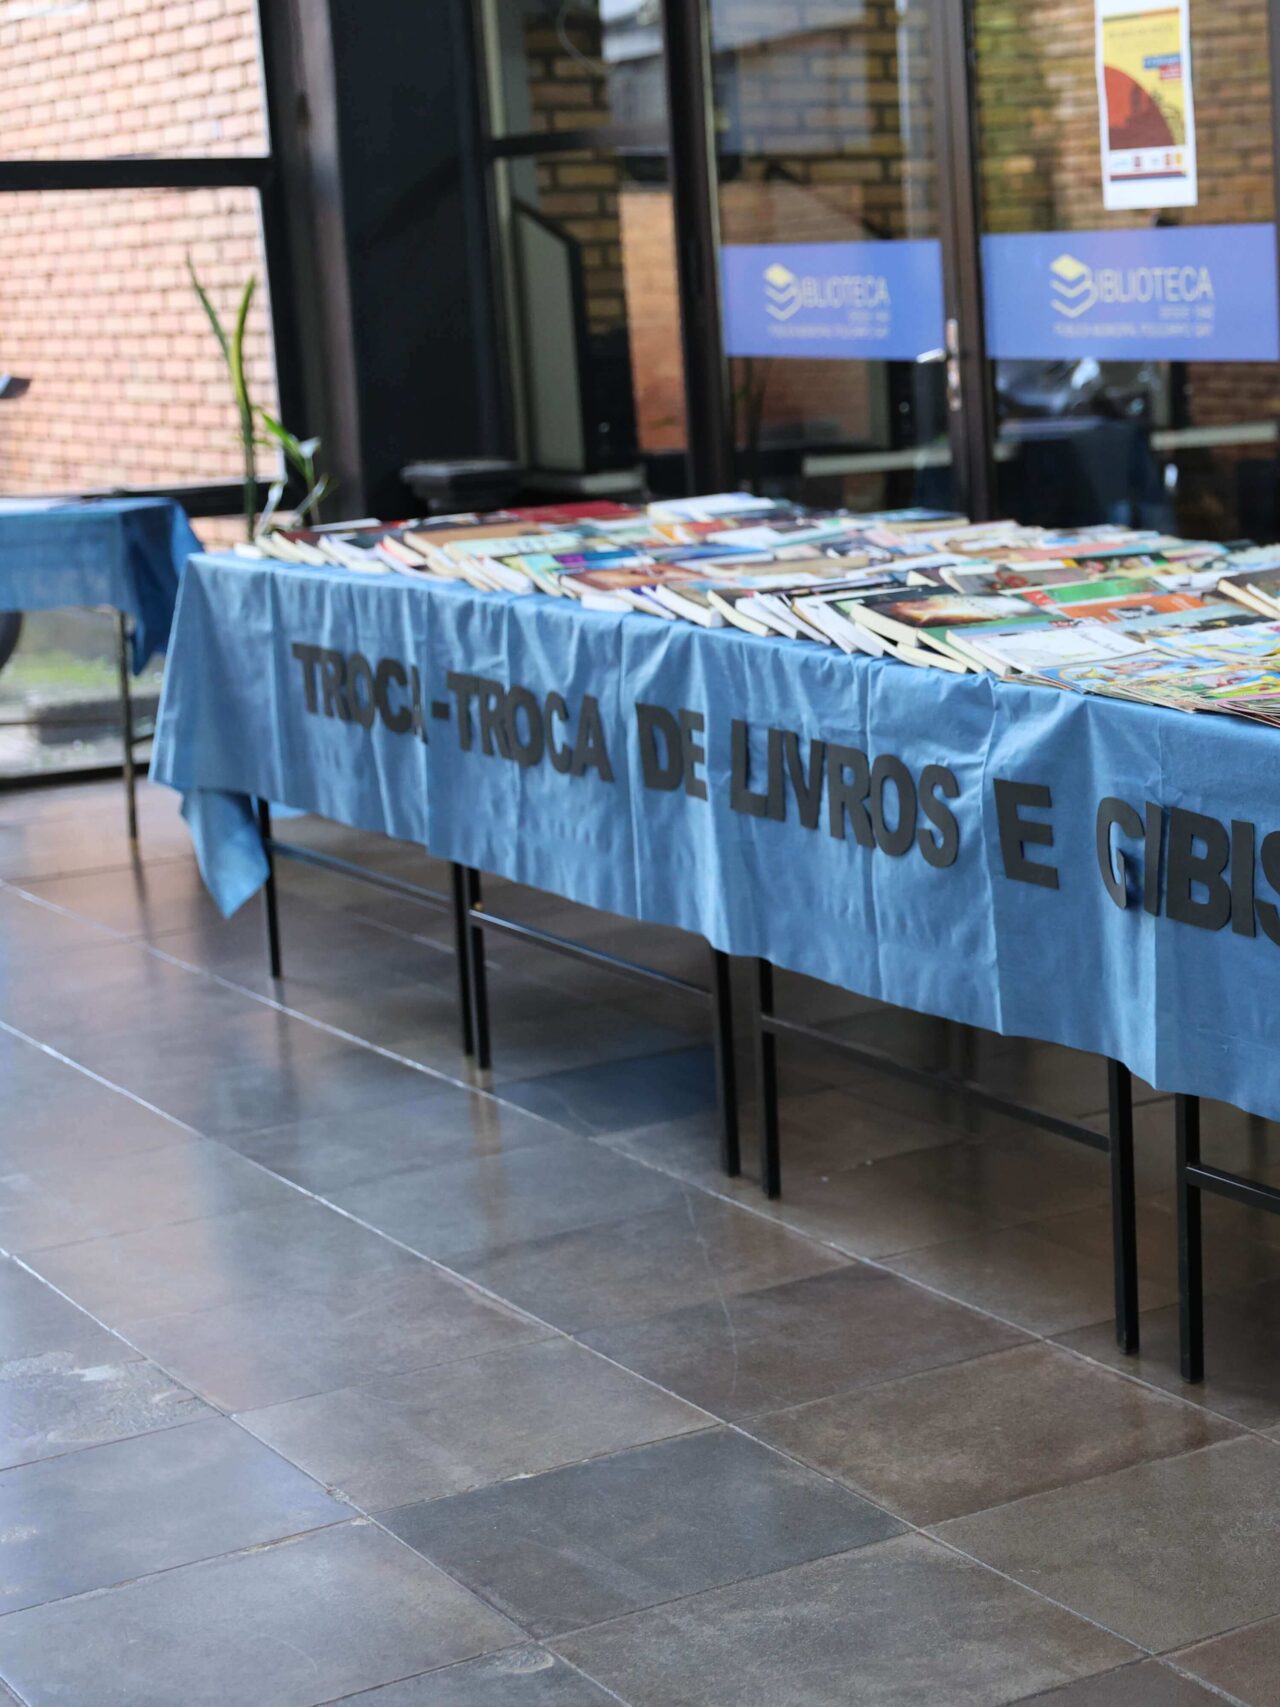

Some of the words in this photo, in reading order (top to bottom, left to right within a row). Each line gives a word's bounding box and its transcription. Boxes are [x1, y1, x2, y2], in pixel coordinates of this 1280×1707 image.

[635, 702, 709, 801] DE
[730, 719, 959, 869] LIVROS
[993, 777, 1059, 890] E
